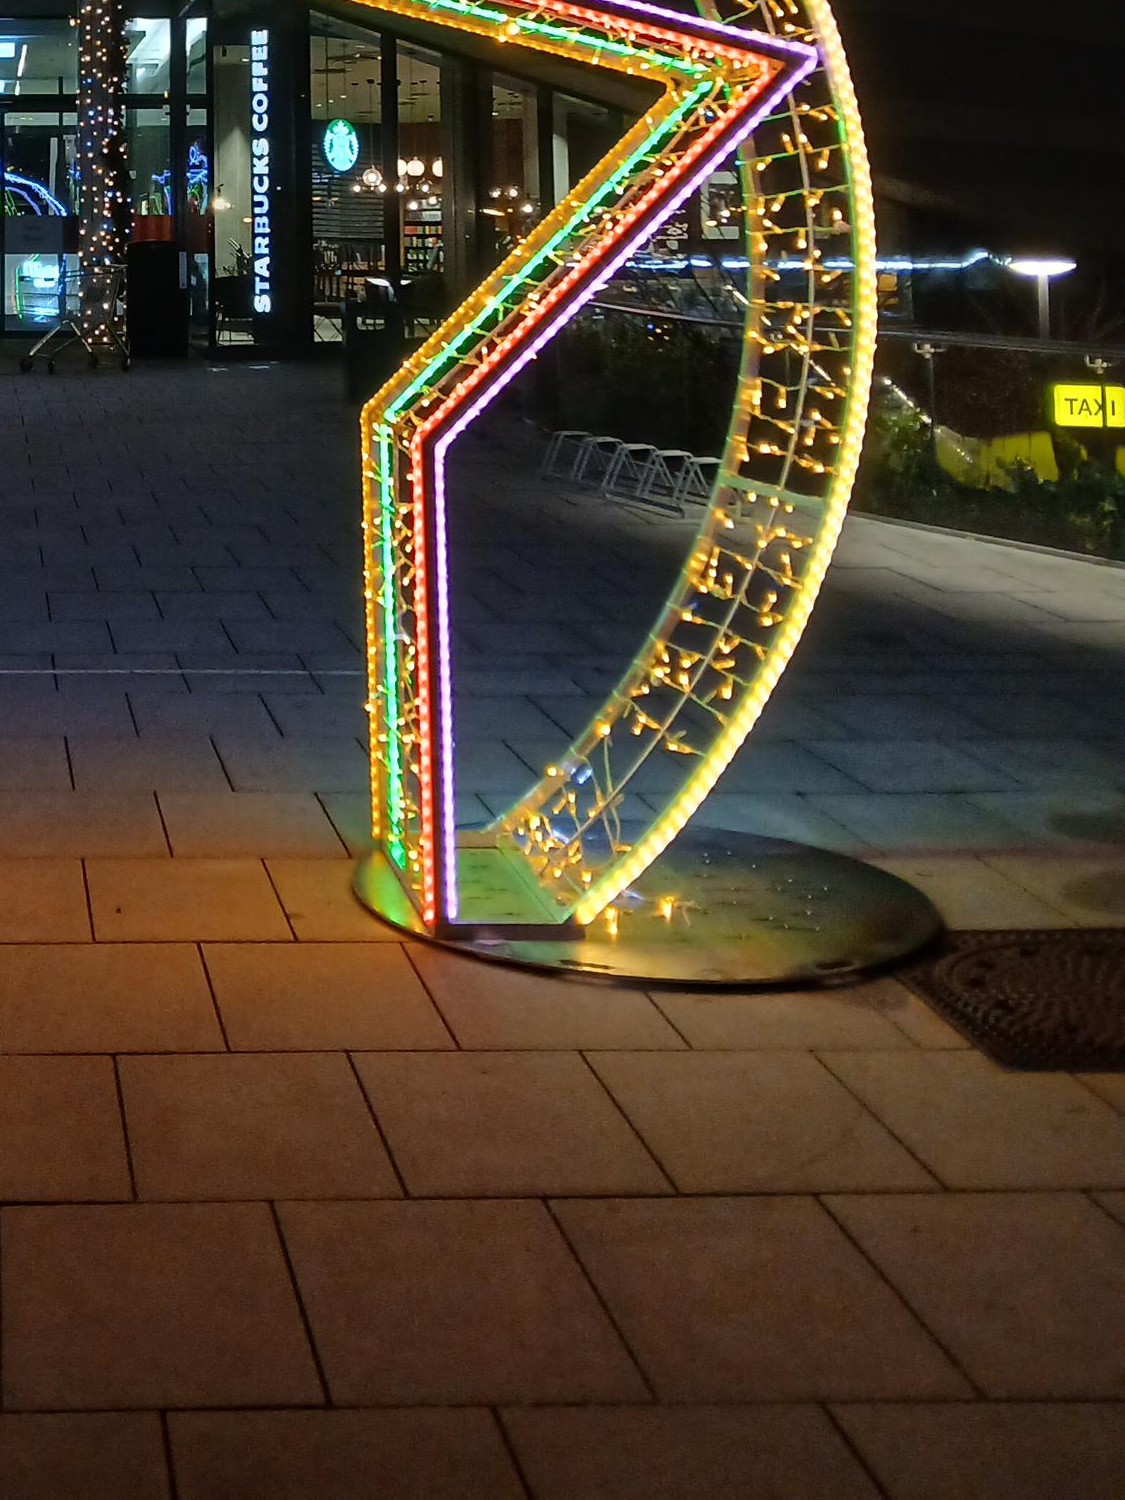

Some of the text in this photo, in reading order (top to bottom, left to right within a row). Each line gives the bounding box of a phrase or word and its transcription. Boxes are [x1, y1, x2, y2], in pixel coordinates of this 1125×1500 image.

[250, 29, 271, 314] STARBUCKS COFFEE
[1064, 397, 1116, 417] TAXI
